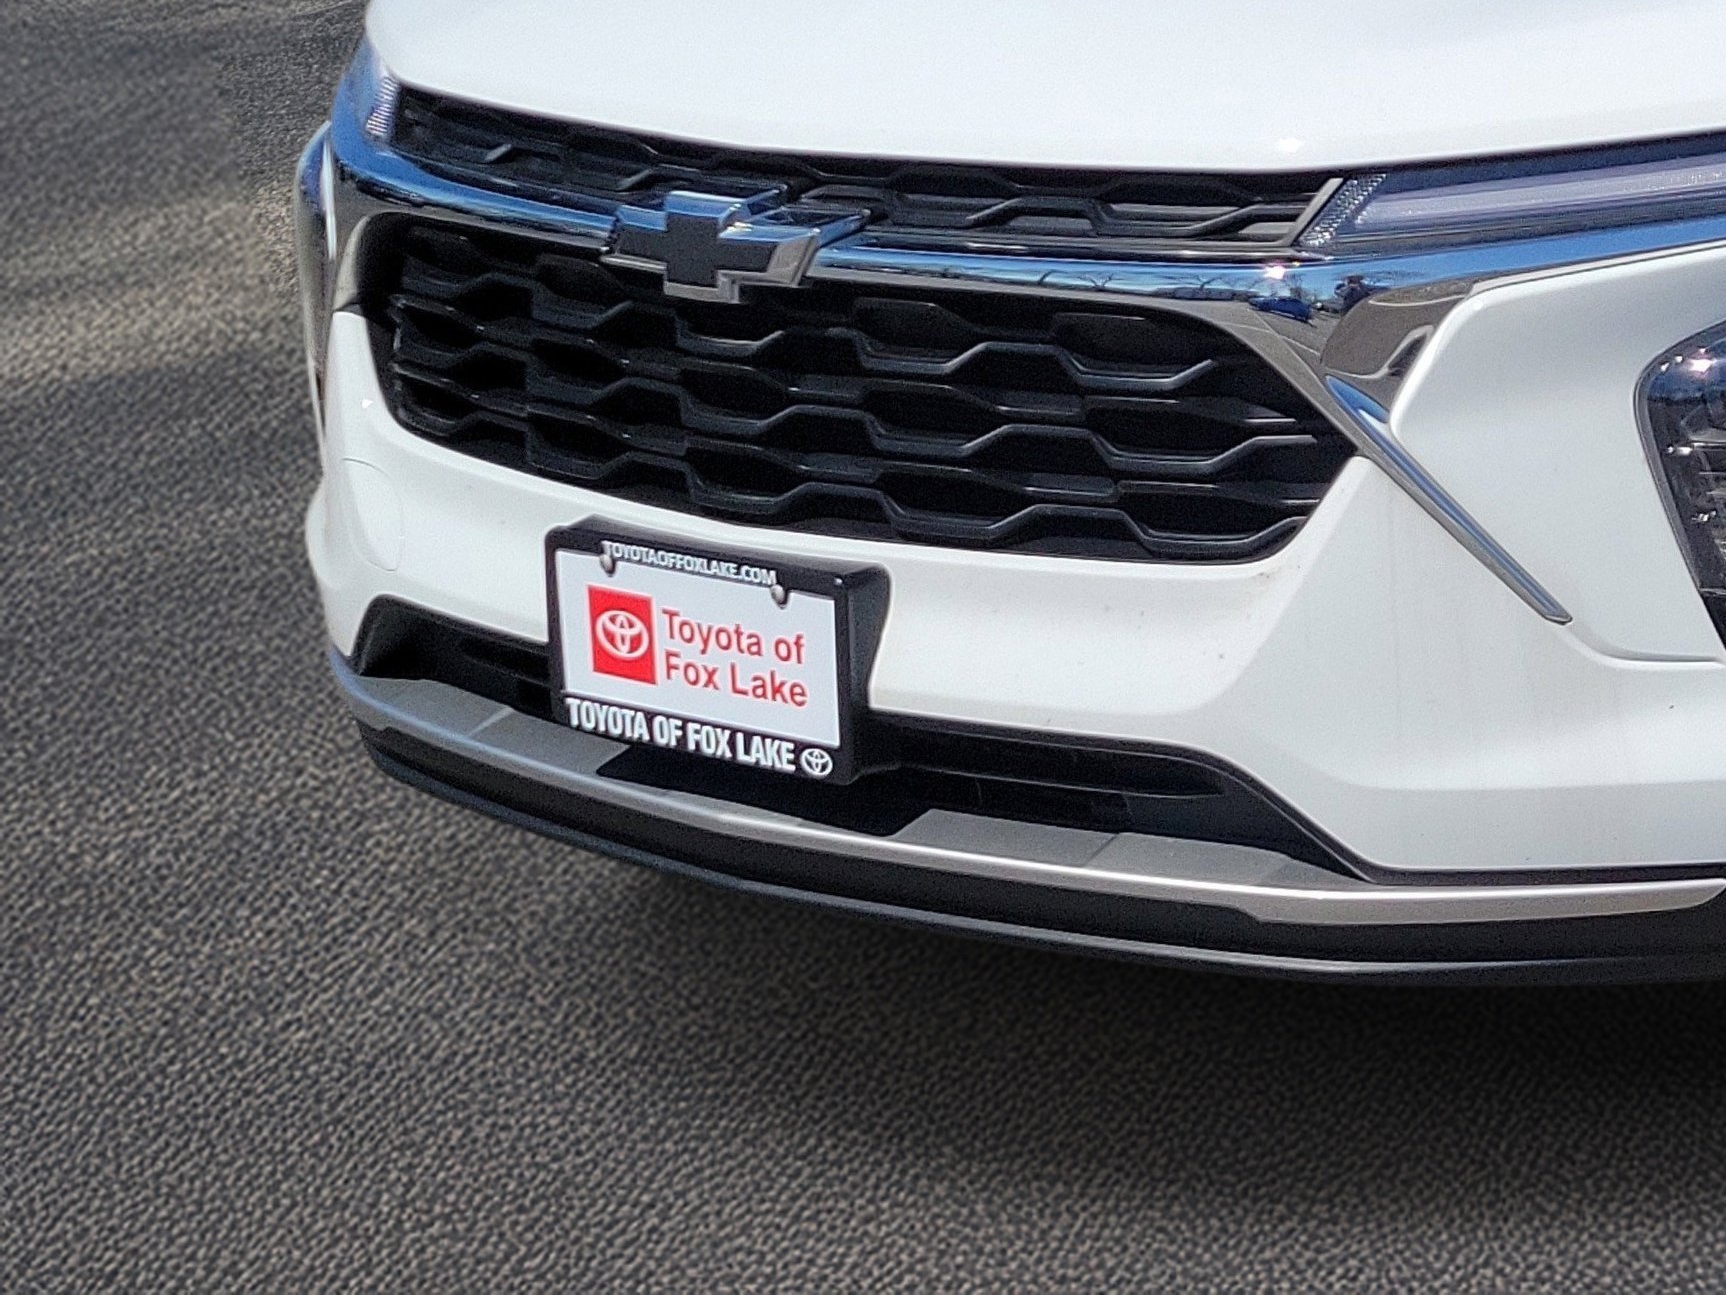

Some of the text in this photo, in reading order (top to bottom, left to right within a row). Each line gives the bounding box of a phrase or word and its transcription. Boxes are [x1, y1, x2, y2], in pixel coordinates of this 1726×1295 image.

[602, 541, 777, 585] TOYOTAOFFOXLAKE.COM
[662, 609, 804, 664] Toyota of
[664, 650, 808, 707] Fox Lake
[566, 698, 796, 771] TOYOTA OF FOX LAKE
